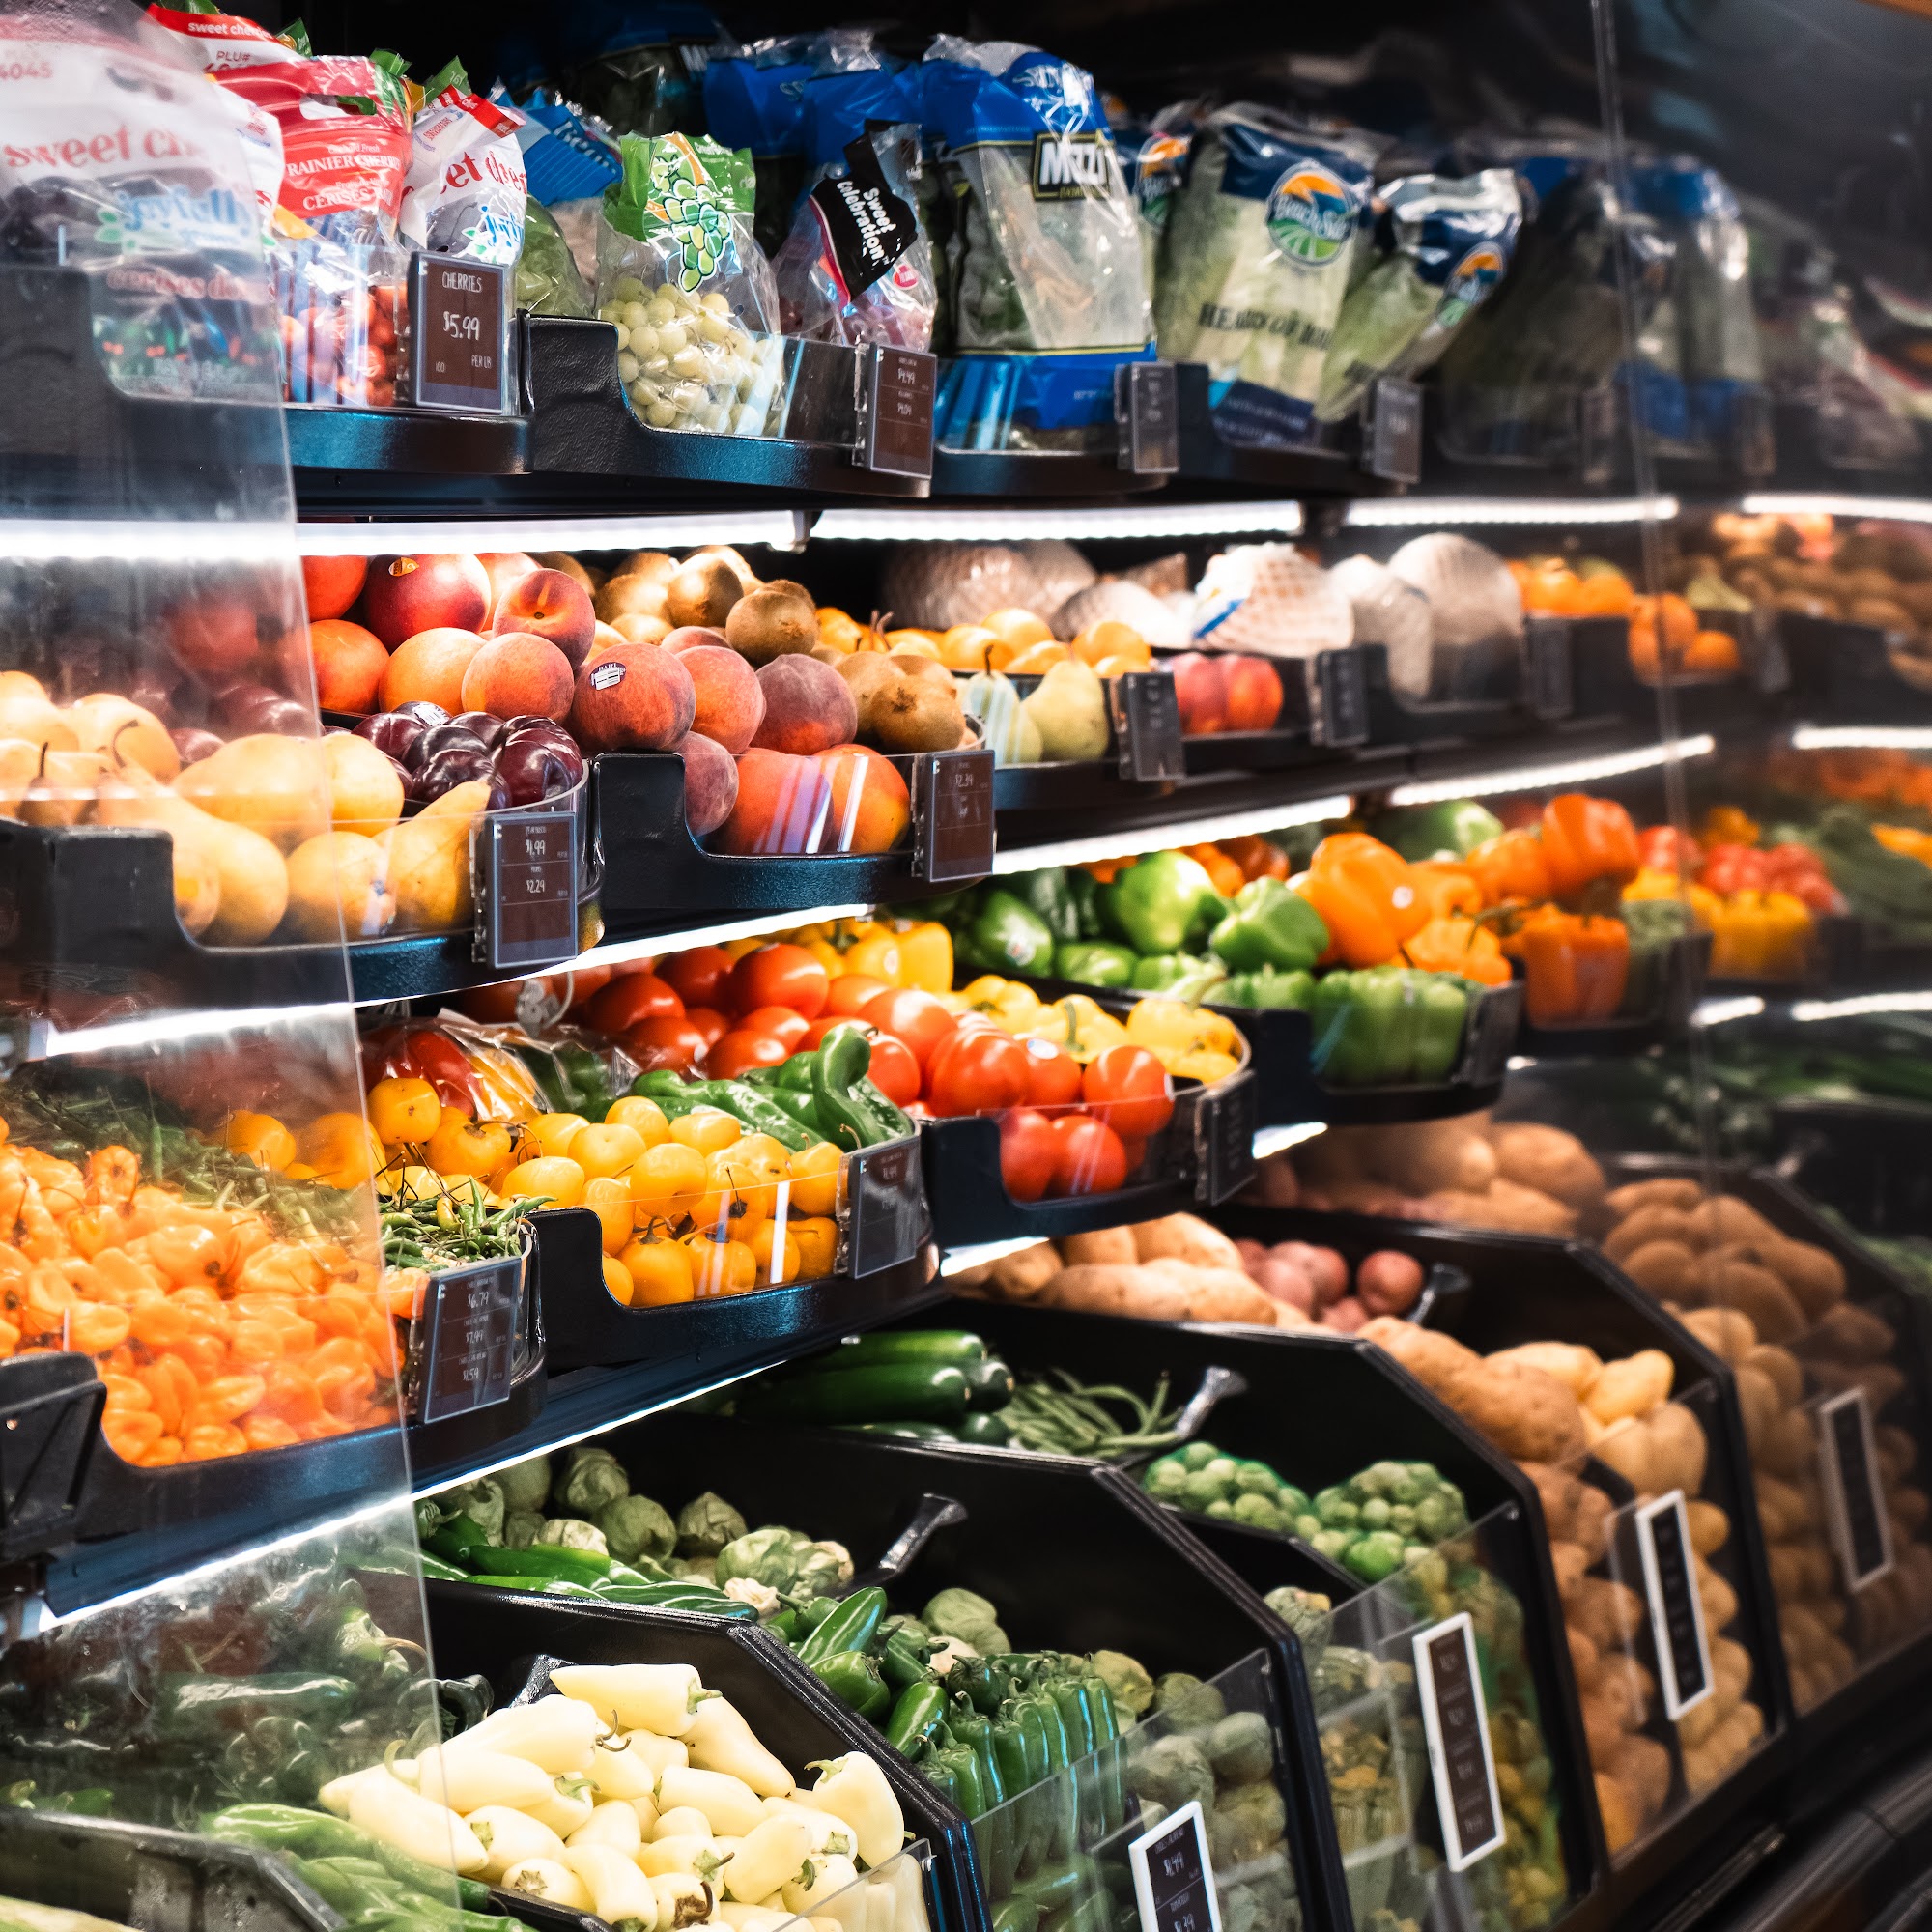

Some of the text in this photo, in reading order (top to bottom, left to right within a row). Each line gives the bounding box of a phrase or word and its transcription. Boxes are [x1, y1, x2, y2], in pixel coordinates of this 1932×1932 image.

[187, 22, 228, 35] sweet
[215, 49, 251, 62] PLU#
[4, 124, 131, 168] sweet
[286, 155, 355, 177] RAINIER
[302, 187, 372, 210] CERISES
[863, 186, 897, 234] Sweet
[441, 271, 482, 294] CHERRIES
[442, 310, 481, 341] $5.99
[471, 355, 483, 369] PER
[525, 838, 546, 856] $1.99
[526, 878, 546, 894] $2.29
